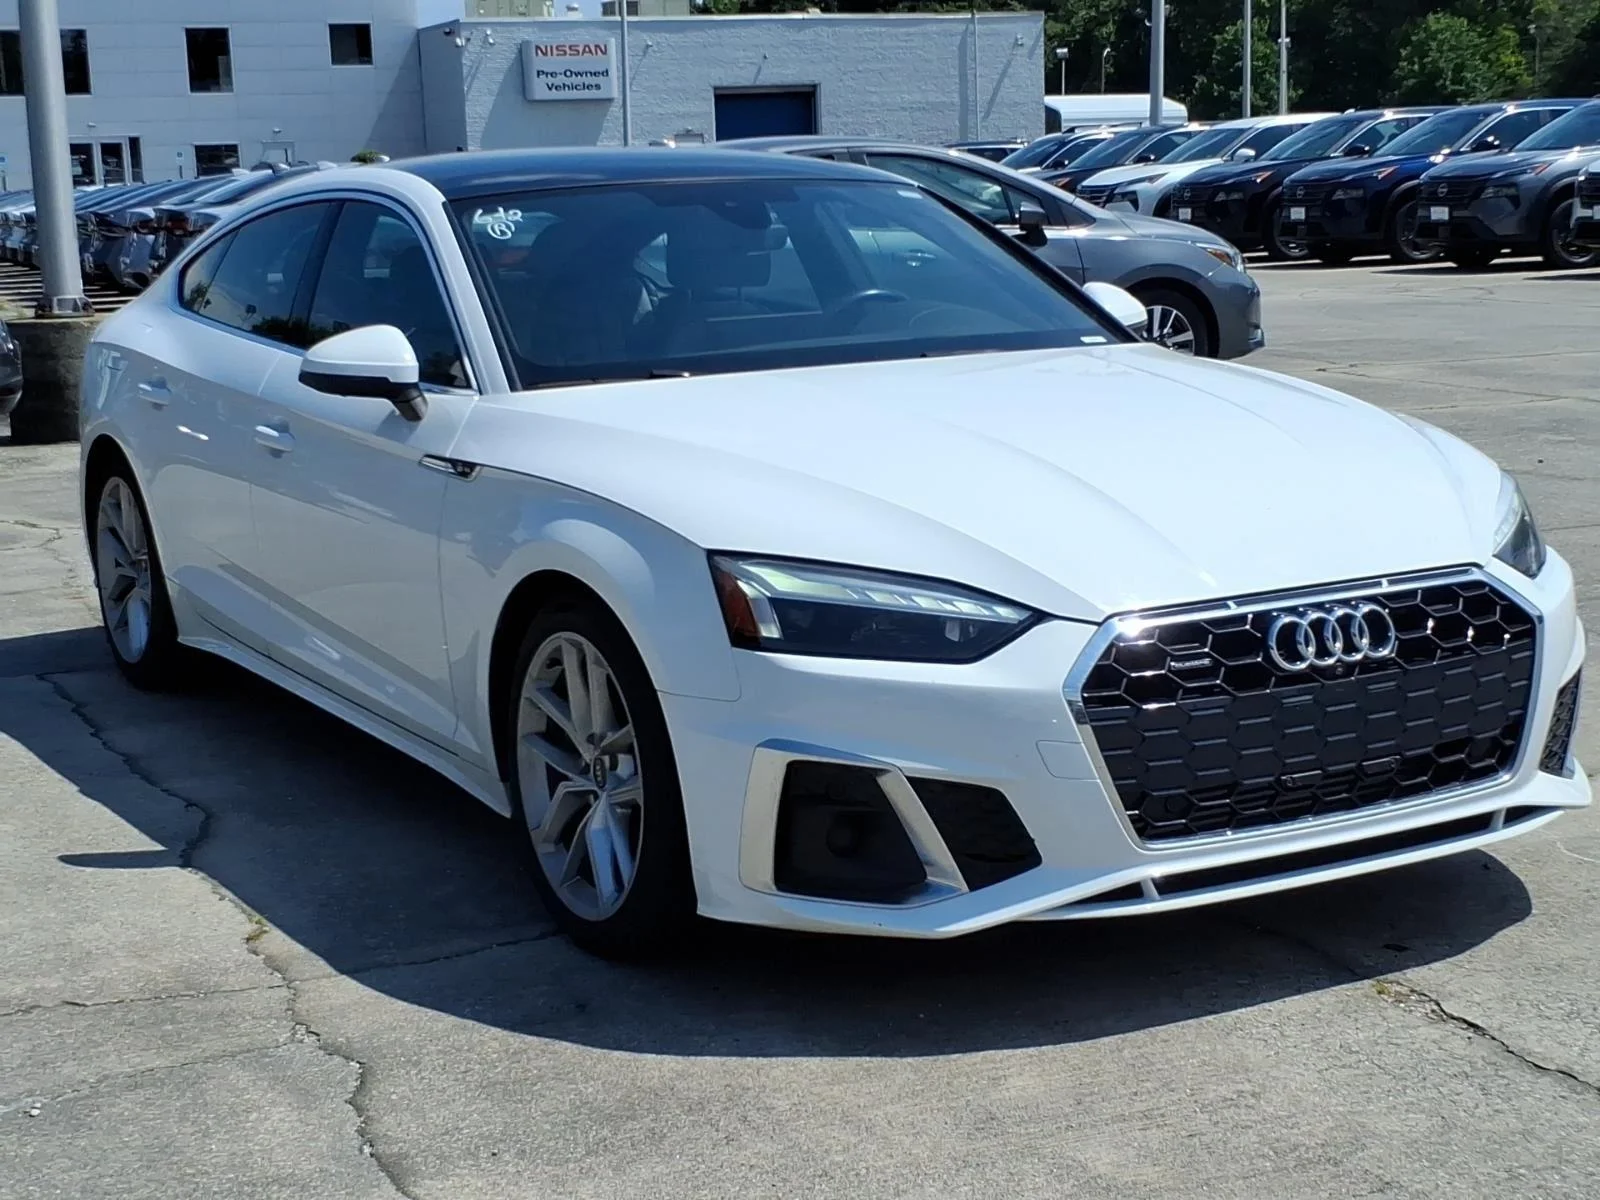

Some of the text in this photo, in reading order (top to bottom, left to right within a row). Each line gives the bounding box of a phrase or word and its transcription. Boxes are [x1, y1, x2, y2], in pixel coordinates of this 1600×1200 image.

[535, 44, 608, 57] NISSAN
[536, 68, 609, 78] Pre-Owned
[546, 82, 602, 92] Vehicles
